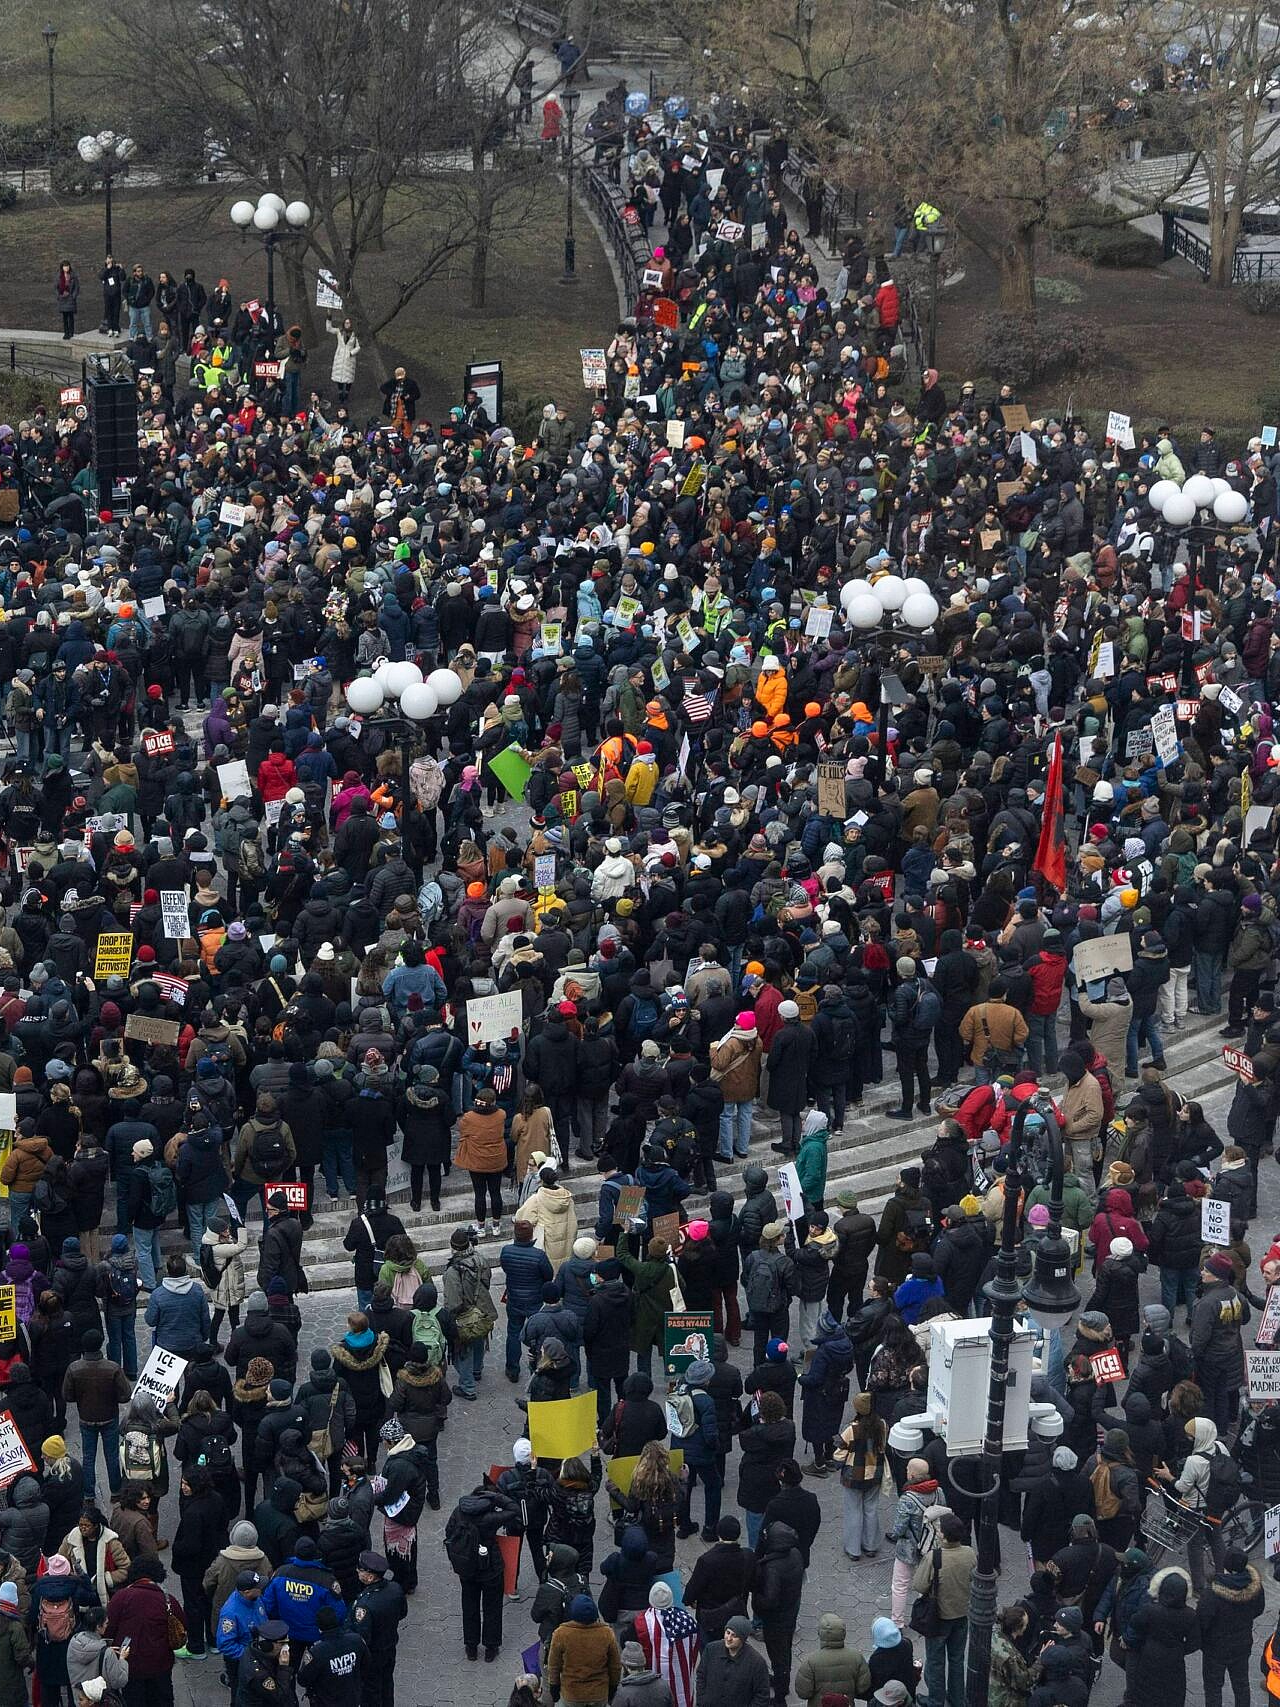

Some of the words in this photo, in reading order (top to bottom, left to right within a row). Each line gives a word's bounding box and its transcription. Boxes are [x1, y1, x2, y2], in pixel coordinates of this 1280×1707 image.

[256, 365, 266, 375] NO
[60, 391, 69, 402] NO
[241, 676, 252, 688] NO
[1178, 703, 1190, 715] NO
[145, 738, 156, 752] NO
[156, 734, 172, 749] ICE!
[162, 893, 185, 906] DEFEND
[100, 936, 119, 946] DROP
[119, 934, 131, 945] THE
[98, 947, 122, 956] CHARGES
[97, 961, 128, 971] ACTIVISTS!
[1224, 1049, 1237, 1065] NO
[1240, 1055, 1253, 1075] ICE!
[287, 1188, 304, 1202] ICE!
[1208, 1201, 1222, 1210] NO
[1208, 1215, 1222, 1224] NO
[1208, 1226, 1222, 1234] NO
[3, 1316, 9, 1325] A
[668, 1320, 686, 1328] PASS
[686, 1319, 711, 1328] NY4ALL
[157, 1350, 176, 1368] ICE
[1249, 1356, 1271, 1365] SPEAK
[1266, 1526, 1278, 1540] OF
[285, 1580, 313, 1596] NYPD
[330, 1652, 357, 1670] NYPD
